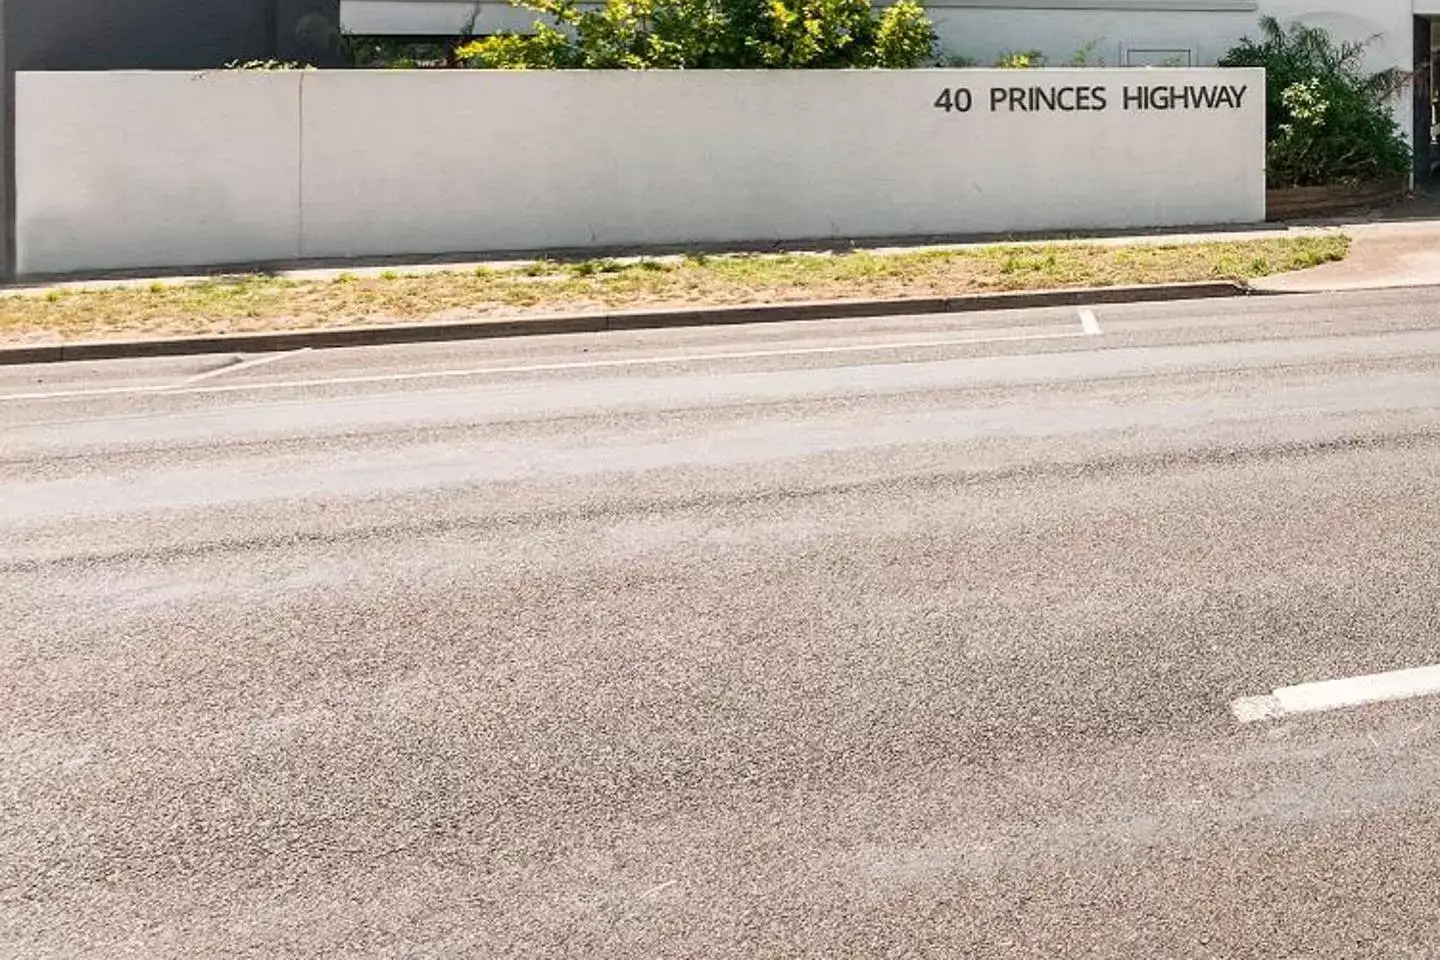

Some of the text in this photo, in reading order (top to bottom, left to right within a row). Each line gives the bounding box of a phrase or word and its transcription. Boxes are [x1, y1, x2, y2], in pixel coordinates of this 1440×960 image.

[934, 84, 1248, 112] 40 PRINCES HIGHWAY
